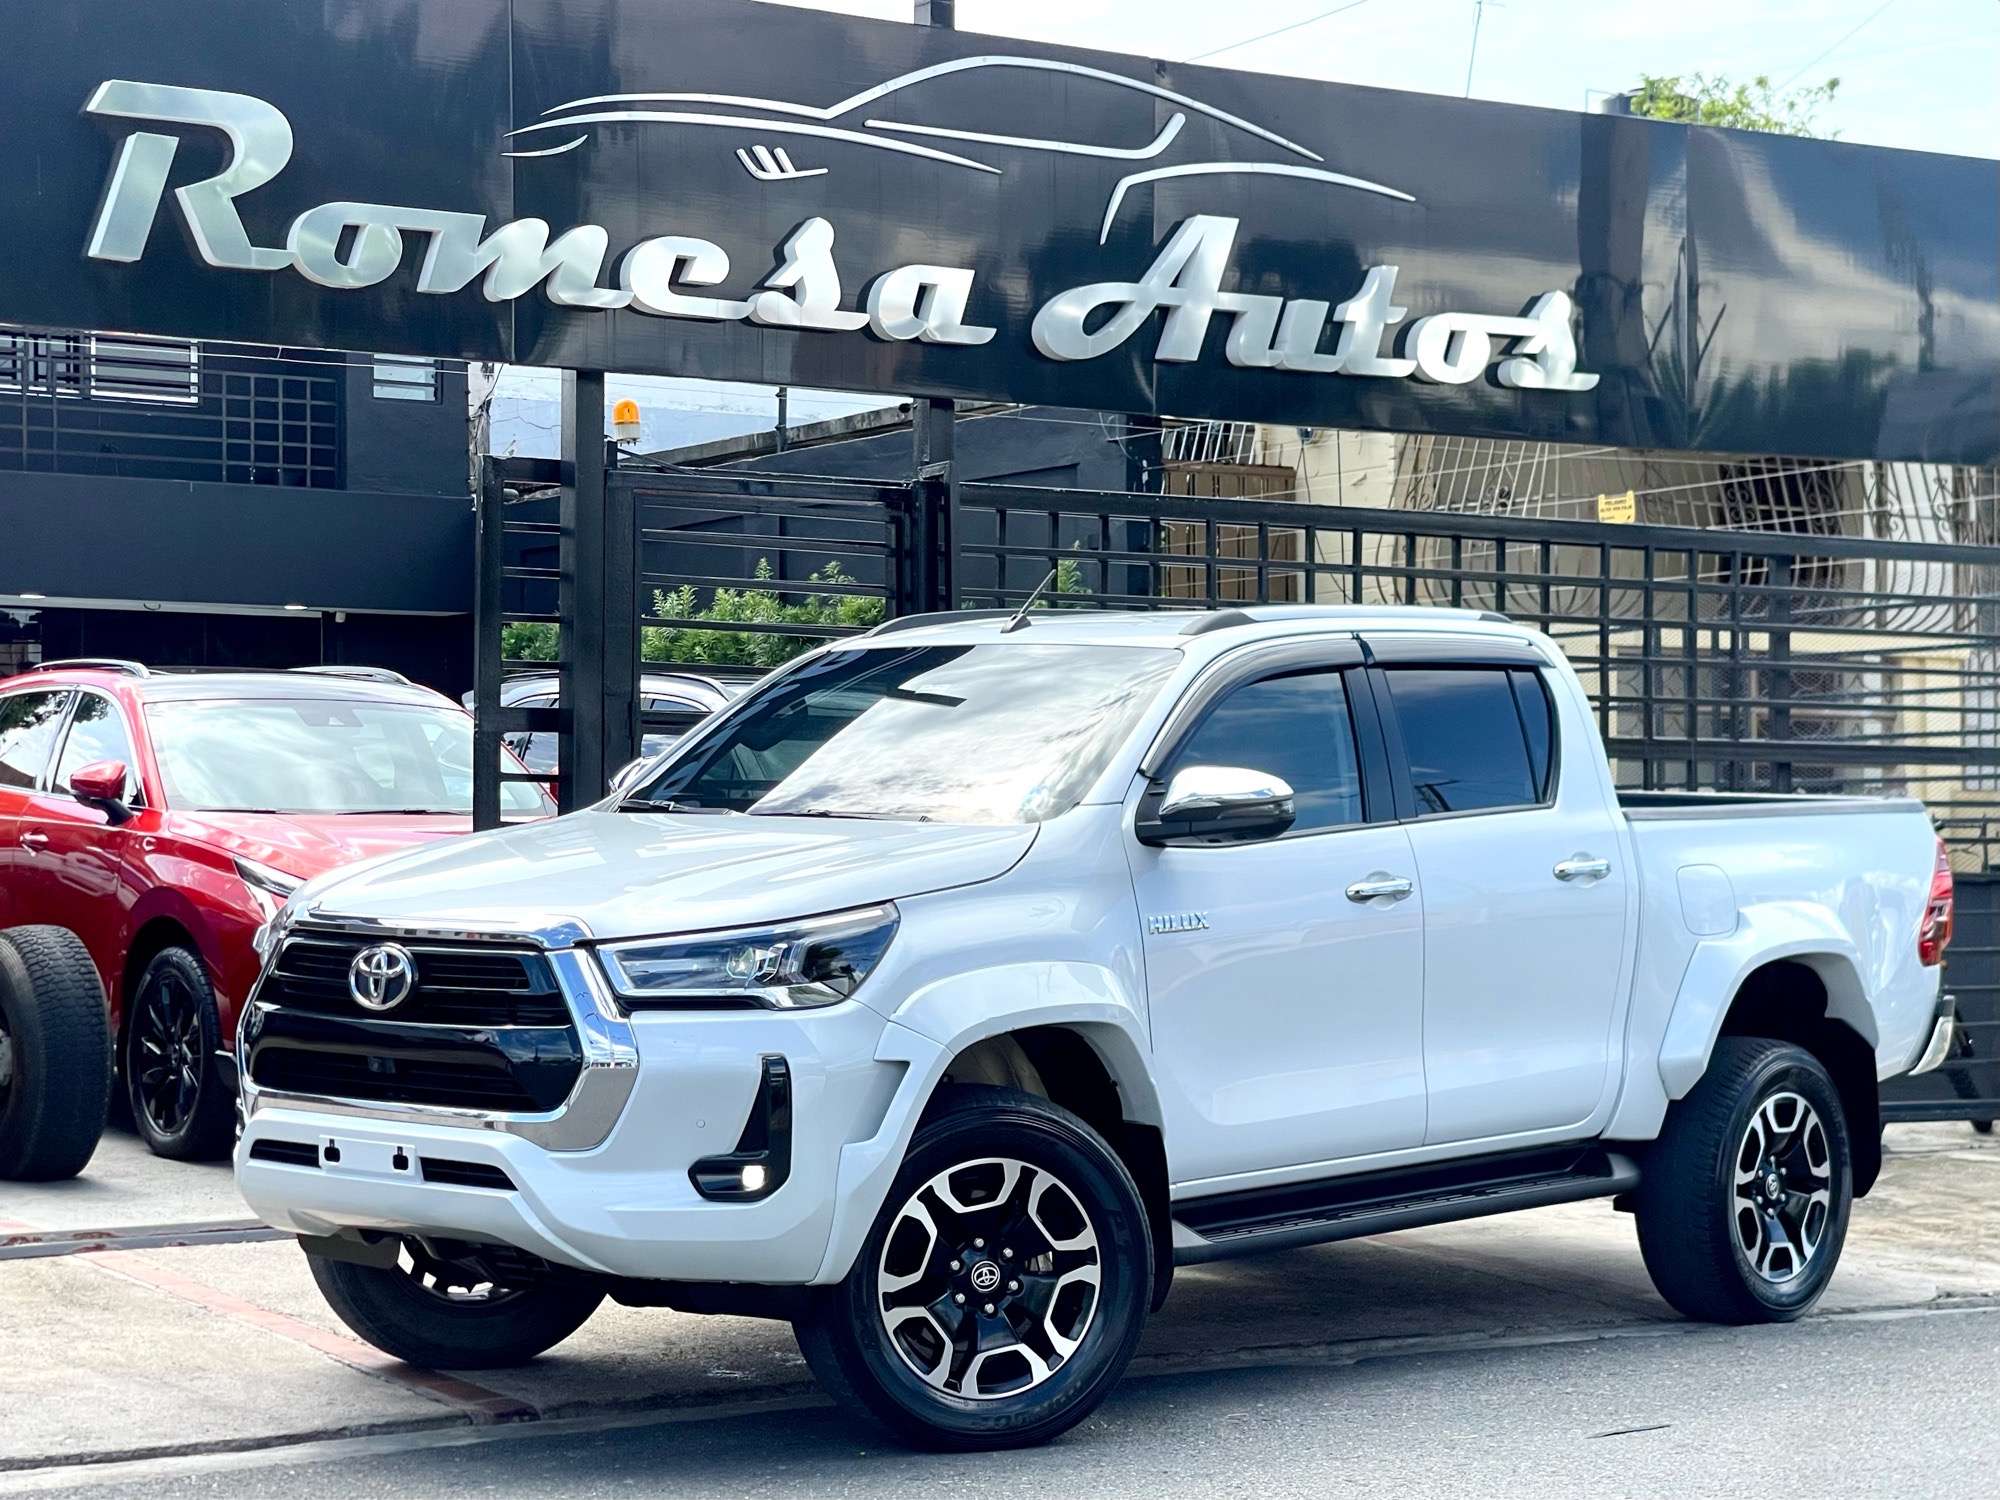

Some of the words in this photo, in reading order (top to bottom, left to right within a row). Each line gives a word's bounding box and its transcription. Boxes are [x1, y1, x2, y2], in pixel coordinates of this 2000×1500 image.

[86, 79, 997, 345] Romesa
[1031, 214, 1599, 391] Autos
[1148, 912, 1209, 935] HILUX
